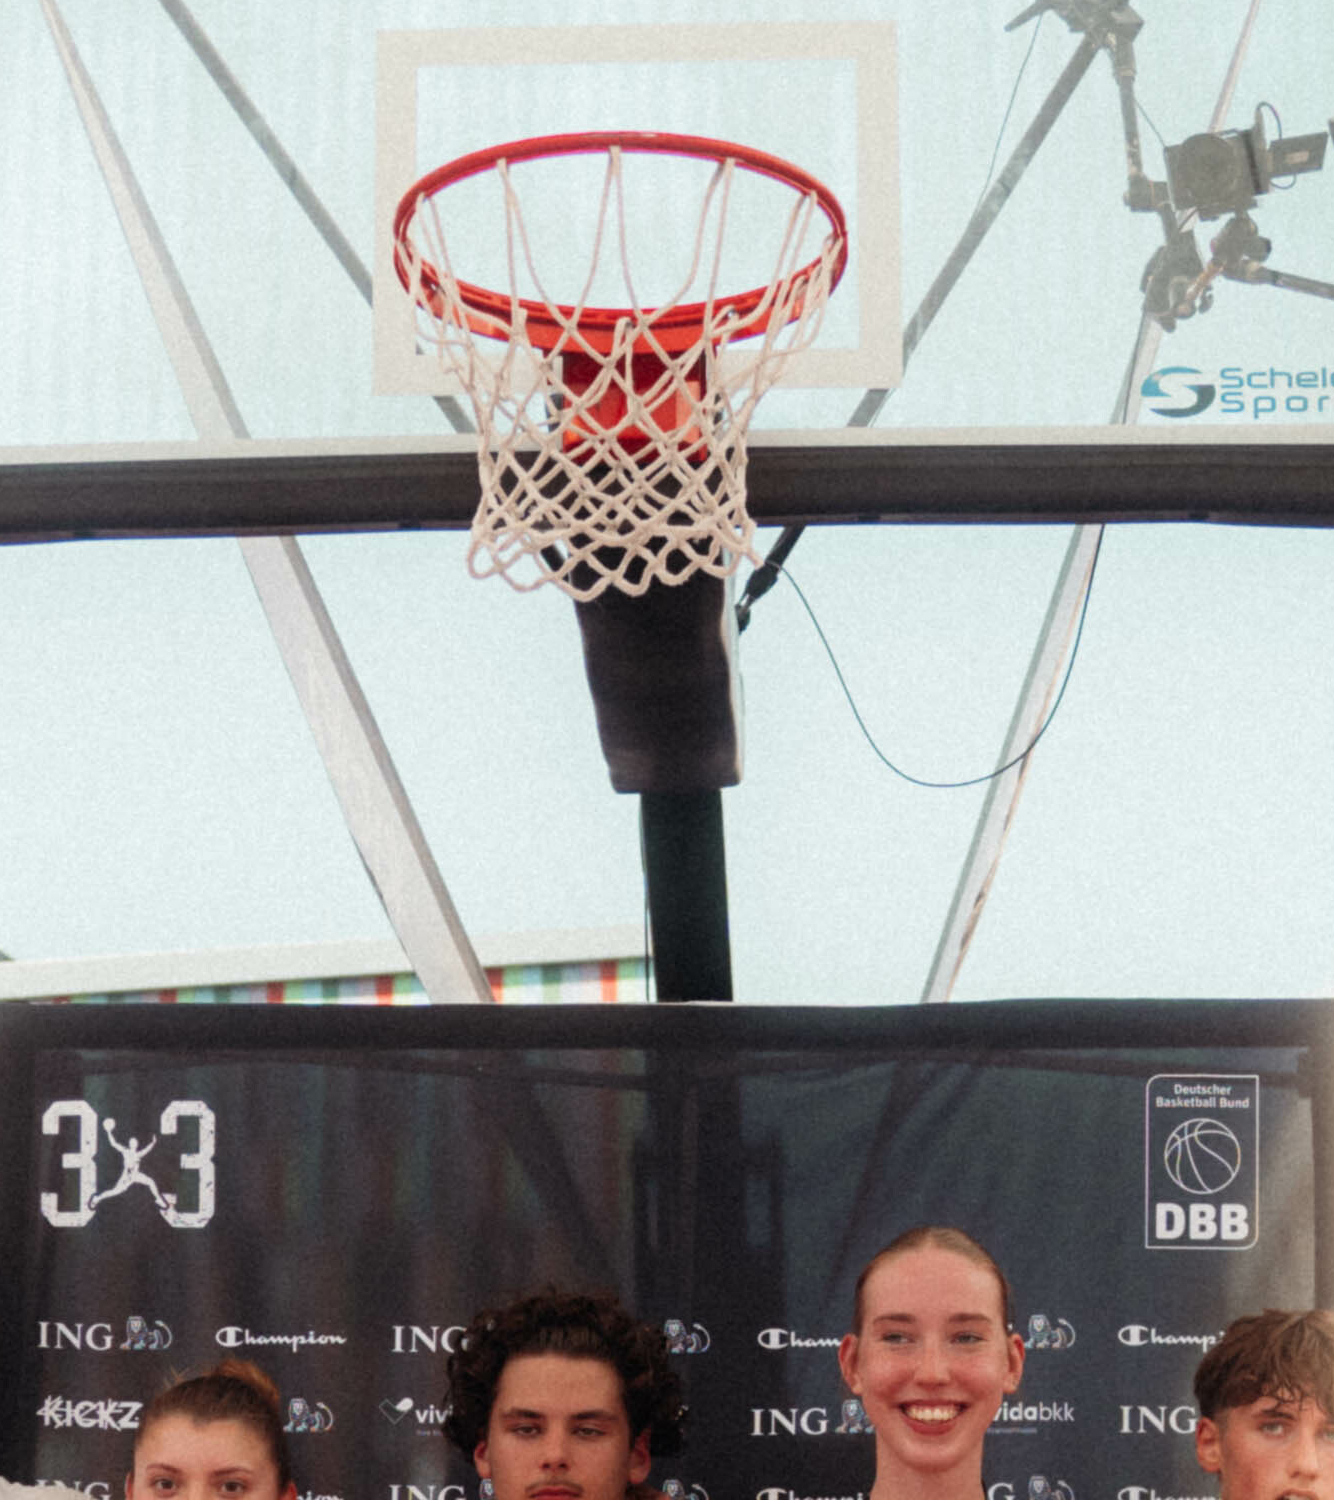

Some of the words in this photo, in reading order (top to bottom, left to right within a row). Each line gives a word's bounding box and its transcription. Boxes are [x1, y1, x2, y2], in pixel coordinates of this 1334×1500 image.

[1155, 1096, 1216, 1108] Basketball
[1219, 1097, 1250, 1108] Bund
[1173, 1083, 1232, 1095] Deutscher
[1155, 1202, 1250, 1240] DBB
[37, 1320, 114, 1351] ING
[215, 1326, 348, 1353] Champion
[36, 1394, 144, 1432] KICKZ
[751, 1407, 830, 1436] ING
[1120, 1405, 1198, 1434] ING
